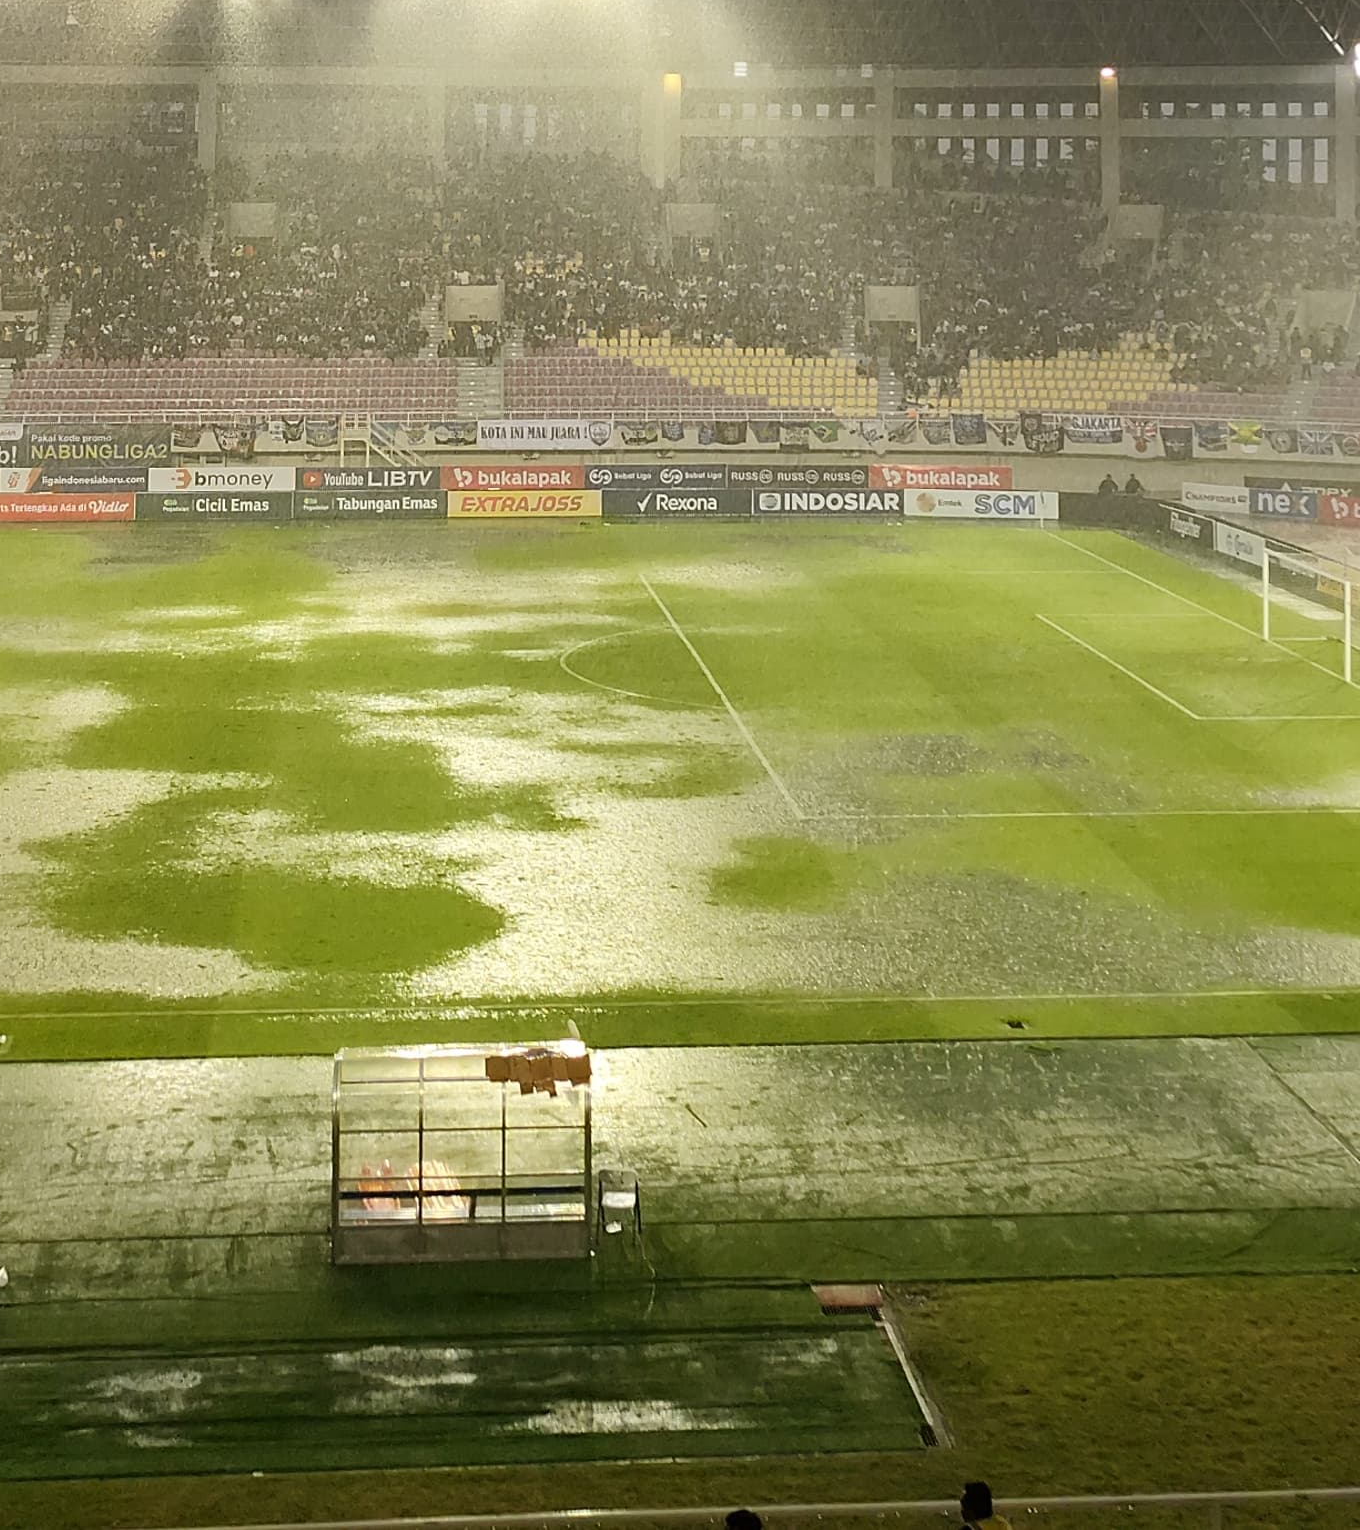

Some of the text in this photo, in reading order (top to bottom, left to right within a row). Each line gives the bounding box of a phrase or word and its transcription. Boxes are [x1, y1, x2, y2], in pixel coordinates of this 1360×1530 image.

[31, 434, 112, 443] Pakai kode promo
[481, 426, 507, 439] KOTA
[510, 426, 524, 439] INI
[527, 426, 548, 439] MAU
[550, 426, 581, 440] JUARA
[31, 444, 167, 459] NABUNGLIGA2
[42, 476, 144, 486] ligaindonesiabaru.com
[195, 472, 273, 489] bmoney
[324, 471, 433, 487] YouTube LIBTV
[478, 470, 571, 487] bukalapak
[906, 471, 1000, 488] bukalapak
[11, 504, 57, 514] Terlengkap
[78, 503, 86, 511] di
[89, 500, 129, 514] Vidio
[196, 499, 227, 512] Cicil
[232, 499, 269, 512] Emas
[336, 498, 400, 513] Tabungan
[402, 497, 438, 510] Emas
[461, 496, 583, 512] EXTRAJOSS
[656, 494, 717, 511] Rexona
[784, 493, 899, 511] INDOSIAR
[975, 494, 1035, 515] SCM
[1257, 493, 1310, 515] nex
